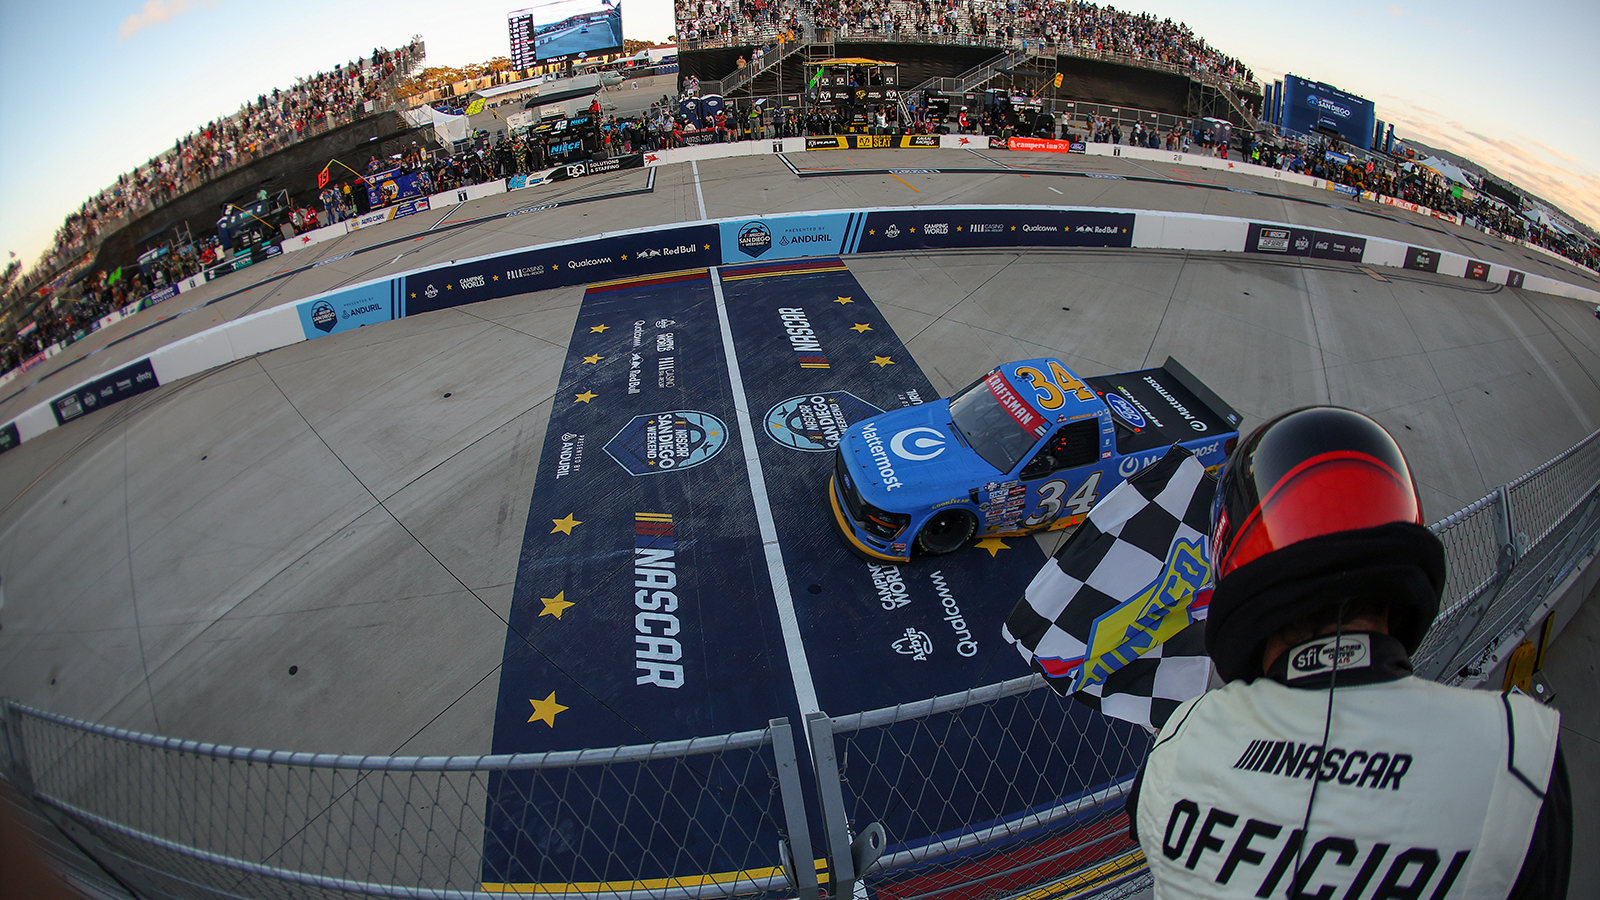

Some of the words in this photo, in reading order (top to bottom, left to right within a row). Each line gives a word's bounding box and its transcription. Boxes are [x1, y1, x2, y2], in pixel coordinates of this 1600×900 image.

[1318, 101, 1331, 109] SAN
[1331, 104, 1351, 116] DIEGO
[554, 120, 568, 130] 42
[570, 117, 588, 126] NIECE
[551, 141, 580, 153] NIECE
[873, 138, 891, 147] SEAT
[1017, 141, 1045, 150] campers
[590, 159, 619, 168] SOLUTIONS
[594, 164, 620, 173] STAFFING
[508, 175, 527, 189] 42
[225, 205, 233, 215] 2
[361, 217, 373, 225] AUTO
[373, 213, 385, 222] CARE
[1022, 224, 1057, 232] Qualcomm
[791, 234, 832, 244] ANDURIL
[663, 246, 679, 256] Red
[680, 244, 696, 254] Bull
[522, 265, 544, 274] CASINO
[568, 257, 612, 269] Qualcomm
[460, 275, 484, 283] CAMPING
[506, 269, 522, 280] PALA
[461, 280, 485, 290] WORLD
[343, 299, 367, 307] PRESENTED
[350, 303, 382, 316] ANDURIL
[633, 320, 646, 348] Qualcomm
[778, 308, 822, 351] NASCAR
[657, 334, 666, 352] WORLD
[629, 370, 641, 381] Red
[666, 369, 675, 388] CASINO
[628, 382, 640, 394] Bull
[1014, 361, 1097, 410] 34
[988, 374, 1033, 425] CRAFTSMAN
[1142, 375, 1195, 420] Mattermost
[810, 396, 832, 427] DIEGO
[1112, 400, 1140, 420] Ford
[1120, 388, 1164, 428] RACING
[658, 414, 673, 434] SAN
[799, 404, 819, 431] NASCAR
[647, 425, 656, 459] WEEKEND
[675, 429, 689, 457] NASCAR
[822, 426, 841, 448] SAN
[574, 435, 585, 463] PRESENTED
[658, 434, 675, 469] DIEGO
[861, 423, 903, 492] Mattermost
[556, 442, 573, 479] ANDURIL
[932, 498, 970, 509] GOODYEAR
[1023, 470, 1104, 526] 34
[635, 547, 685, 689] NASCAR
[930, 570, 978, 657] Qualcomm
[1297, 648, 1317, 668] sfi
[1273, 741, 1414, 791] NASCAR
